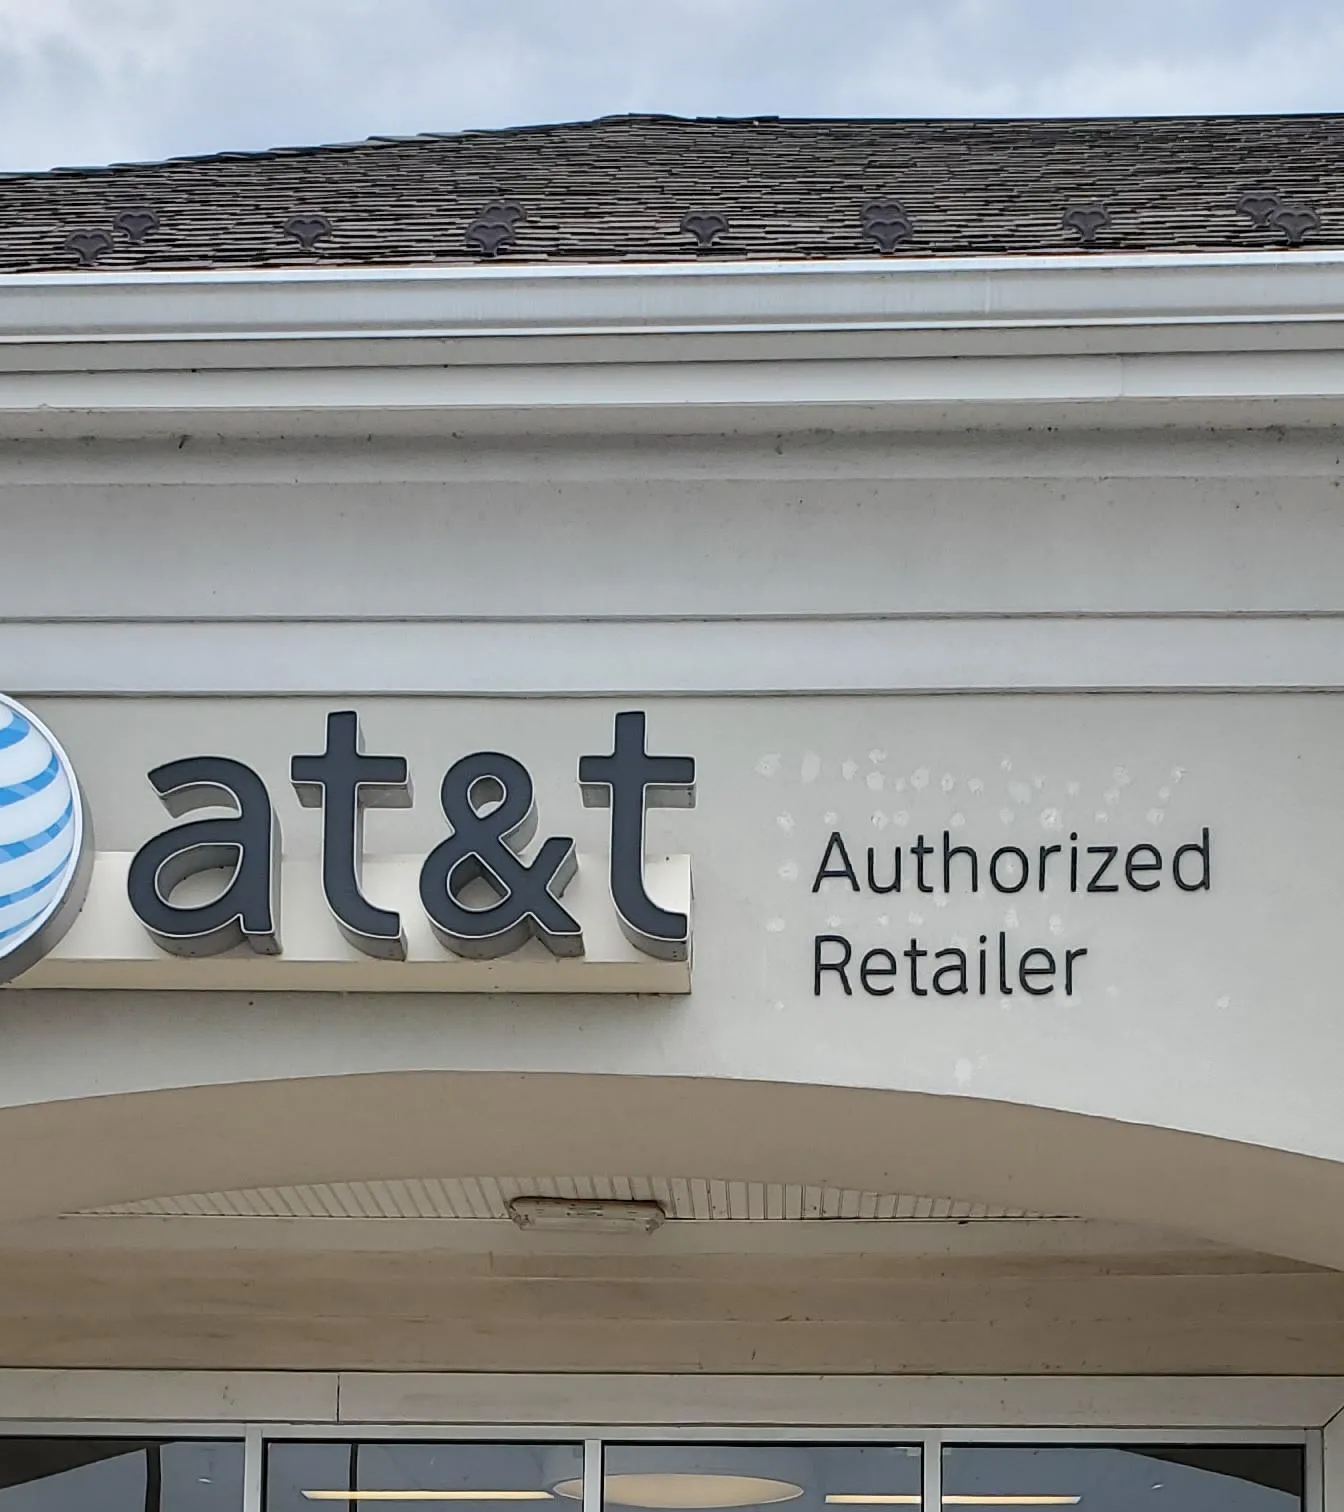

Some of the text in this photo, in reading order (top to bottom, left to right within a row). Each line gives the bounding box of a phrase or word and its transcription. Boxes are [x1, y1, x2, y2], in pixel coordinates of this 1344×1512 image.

[127, 710, 696, 942] at&t
[811, 827, 1211, 894] Authorized
[813, 931, 1088, 997] Retailer
